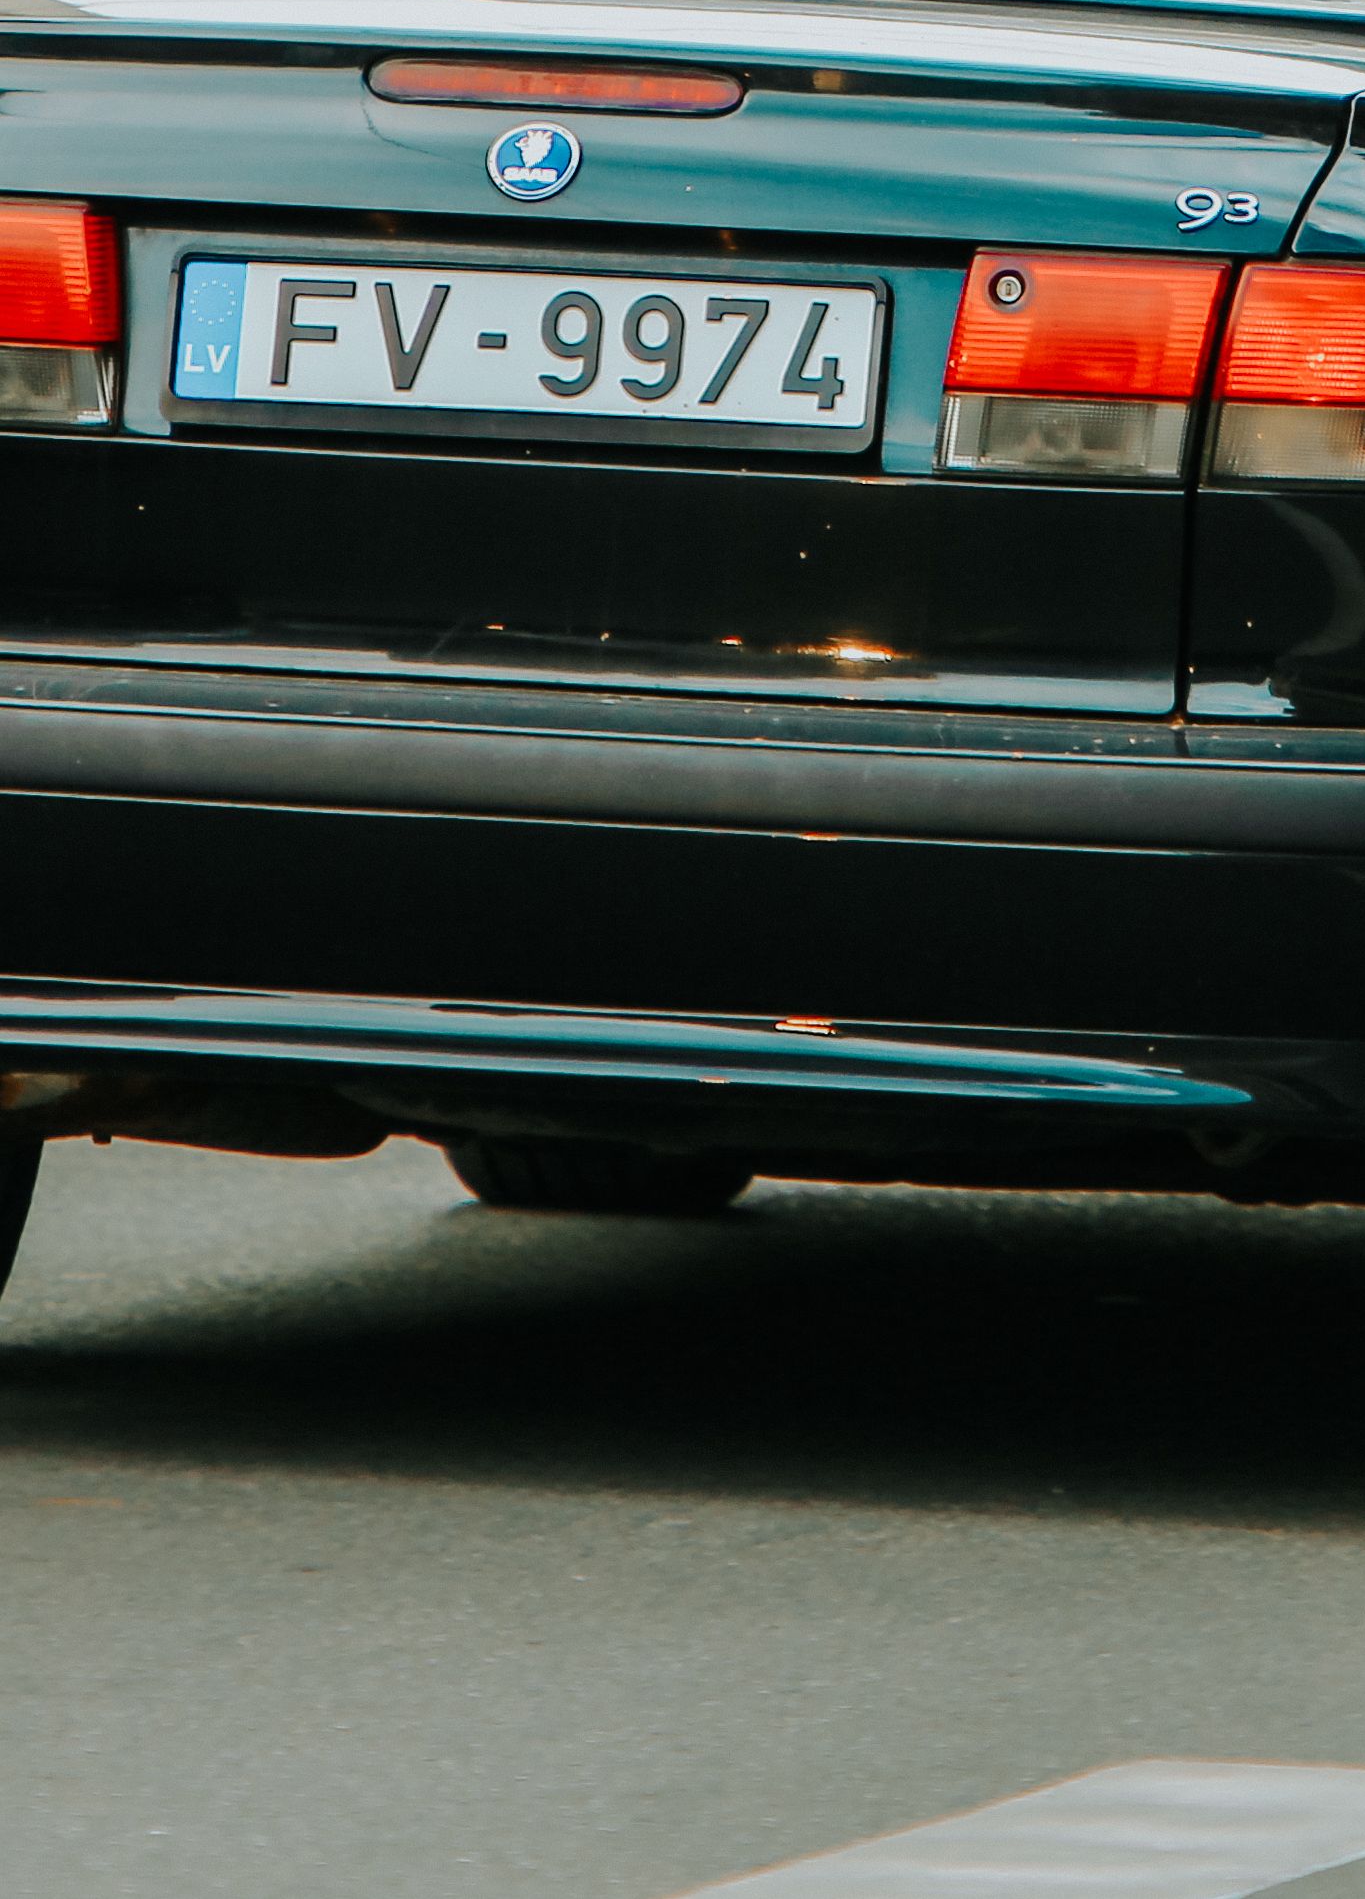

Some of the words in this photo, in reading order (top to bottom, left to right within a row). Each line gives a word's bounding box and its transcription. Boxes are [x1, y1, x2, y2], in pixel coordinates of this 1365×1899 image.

[1175, 187, 1259, 232] 93
[184, 343, 231, 373] LV
[269, 278, 845, 410] FV-9974
